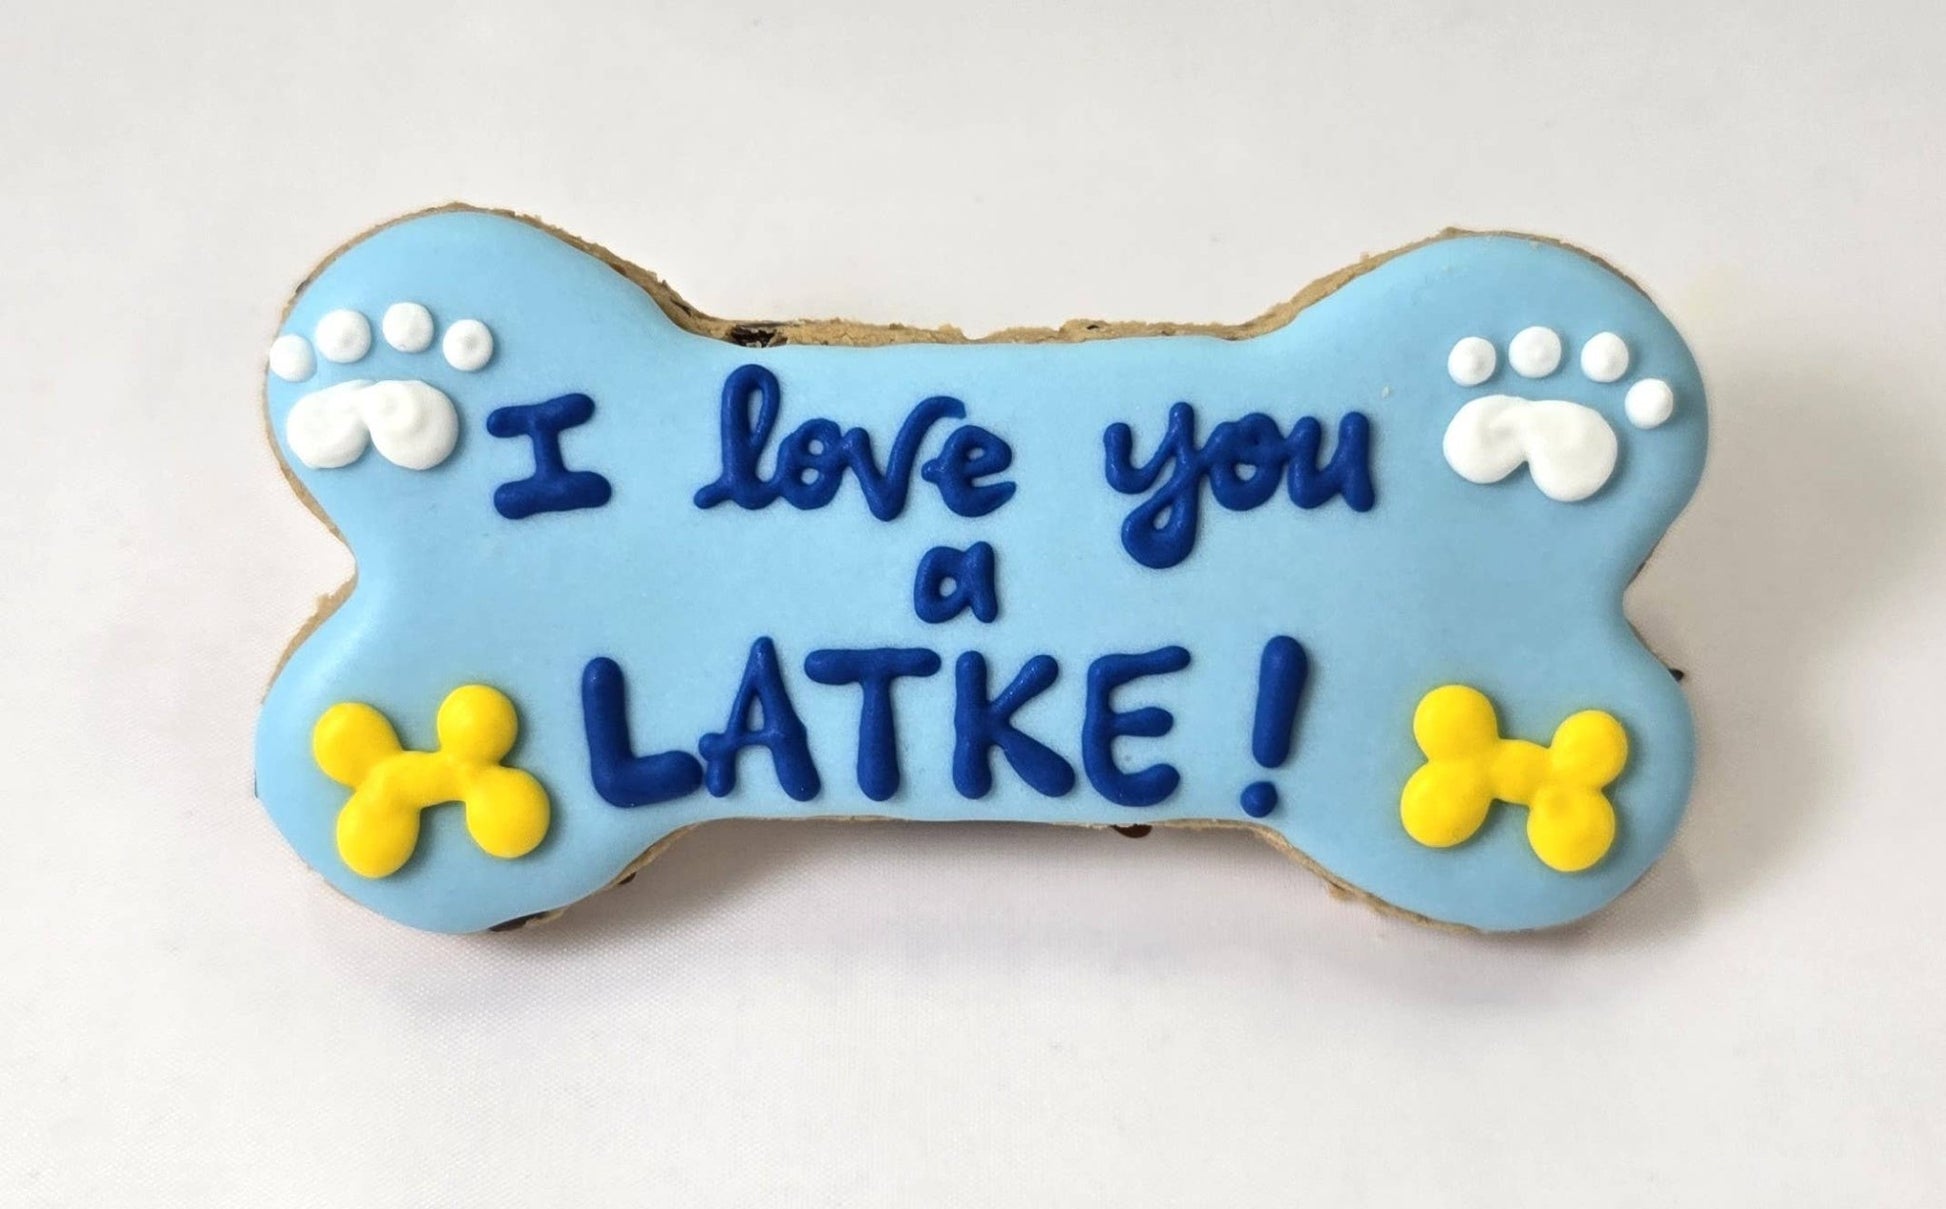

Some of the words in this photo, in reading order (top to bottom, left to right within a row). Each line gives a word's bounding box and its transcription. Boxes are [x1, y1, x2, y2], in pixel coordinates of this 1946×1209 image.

[486, 392, 613, 521] I
[693, 363, 1017, 523] love
[1102, 401, 1379, 570] you
[913, 540, 1001, 625] a
[580, 635, 1310, 819] LATKE!
